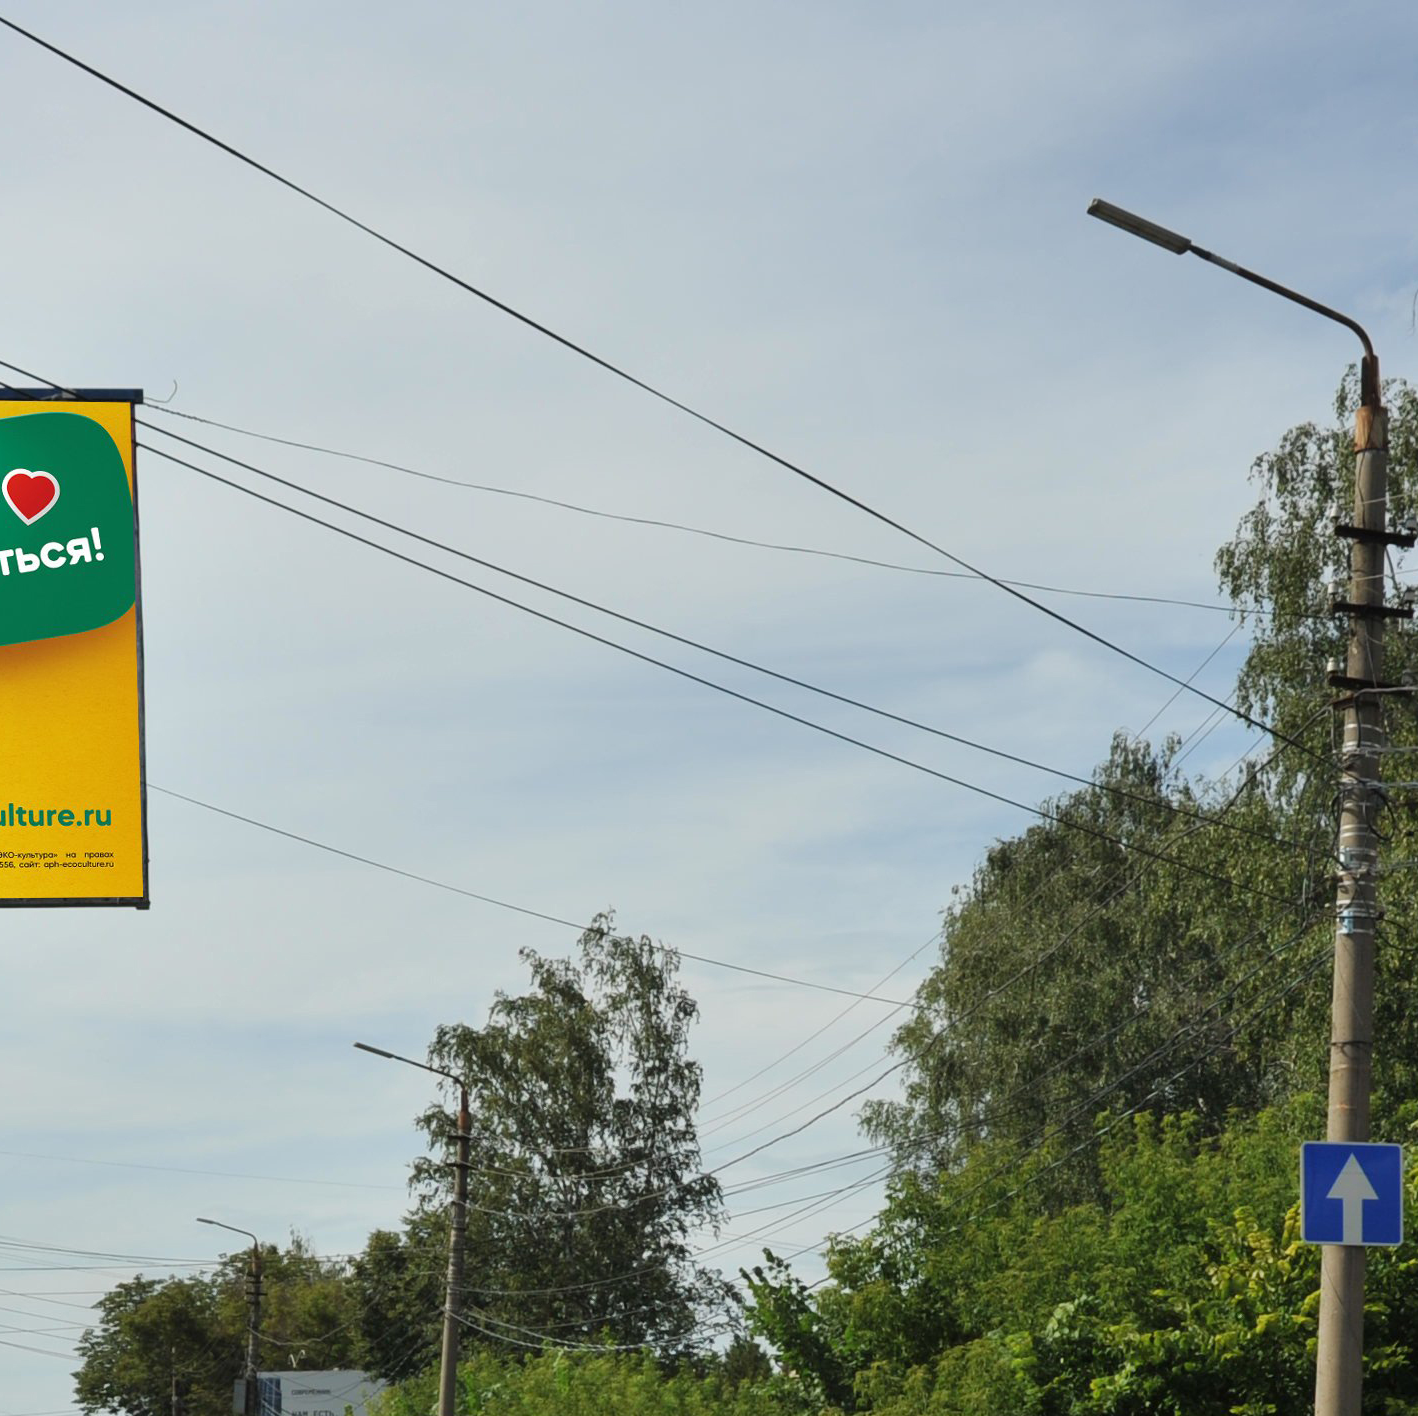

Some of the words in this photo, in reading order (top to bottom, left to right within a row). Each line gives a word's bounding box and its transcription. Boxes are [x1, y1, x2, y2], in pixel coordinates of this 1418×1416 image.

[84, 852, 114, 860] правах
[19, 860, 41, 868] сайт:
[43, 860, 115, 870] aph-ecoculture.ru
